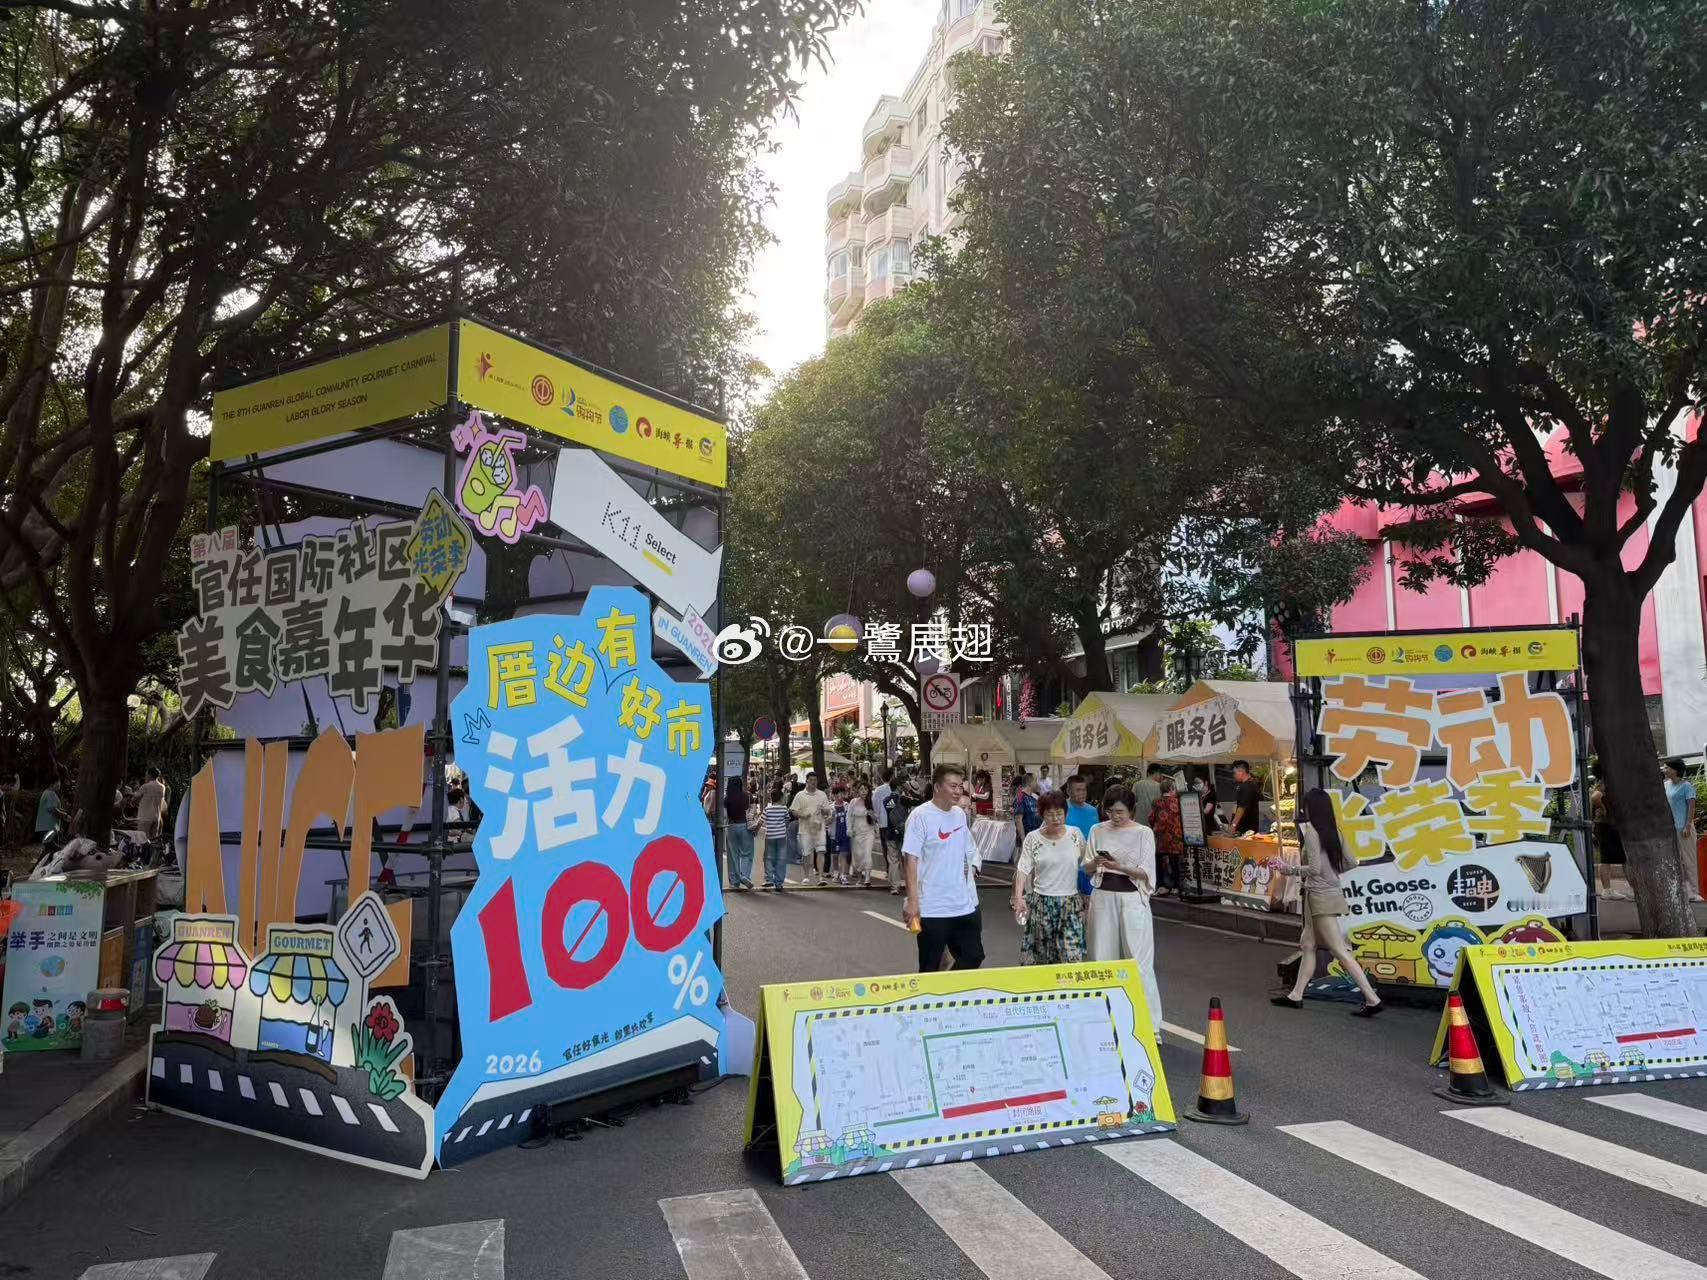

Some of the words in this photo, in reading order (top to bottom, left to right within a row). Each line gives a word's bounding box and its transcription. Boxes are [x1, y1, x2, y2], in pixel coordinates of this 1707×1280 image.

[222, 411, 235, 421] THE
[237, 407, 251, 418] 8TH
[252, 399, 285, 414] GUANREN
[286, 391, 314, 406] GLOBAL
[315, 378, 360, 397] COMMUNITY
[361, 365, 399, 384] GOURMET
[400, 352, 437, 371] CARNIVAL
[286, 408, 310, 423] LABOR
[311, 402, 336, 416] GLORY
[337, 394, 368, 409] SEASON
[191, 529, 238, 559] 第八届
[601, 501, 642, 550] K11
[644, 532, 678, 565] Select
[194, 519, 413, 614] 官任国际社区
[179, 582, 440, 717] 美食嘉年华
[658, 615, 669, 631] IN
[671, 626, 713, 672] GUANREN
[1069, 720, 1110, 753] 服务台
[1166, 712, 1228, 751] 服务台
[1318, 671, 1575, 790] 劳动
[484, 714, 667, 860] 活力
[1366, 878, 1437, 896] Goose.
[1365, 896, 1403, 914] fun.
[10, 930, 45, 951] 举手
[176, 925, 232, 939] GUANREN
[273, 935, 331, 951] GOURMET
[485, 1050, 542, 1075] 2026
